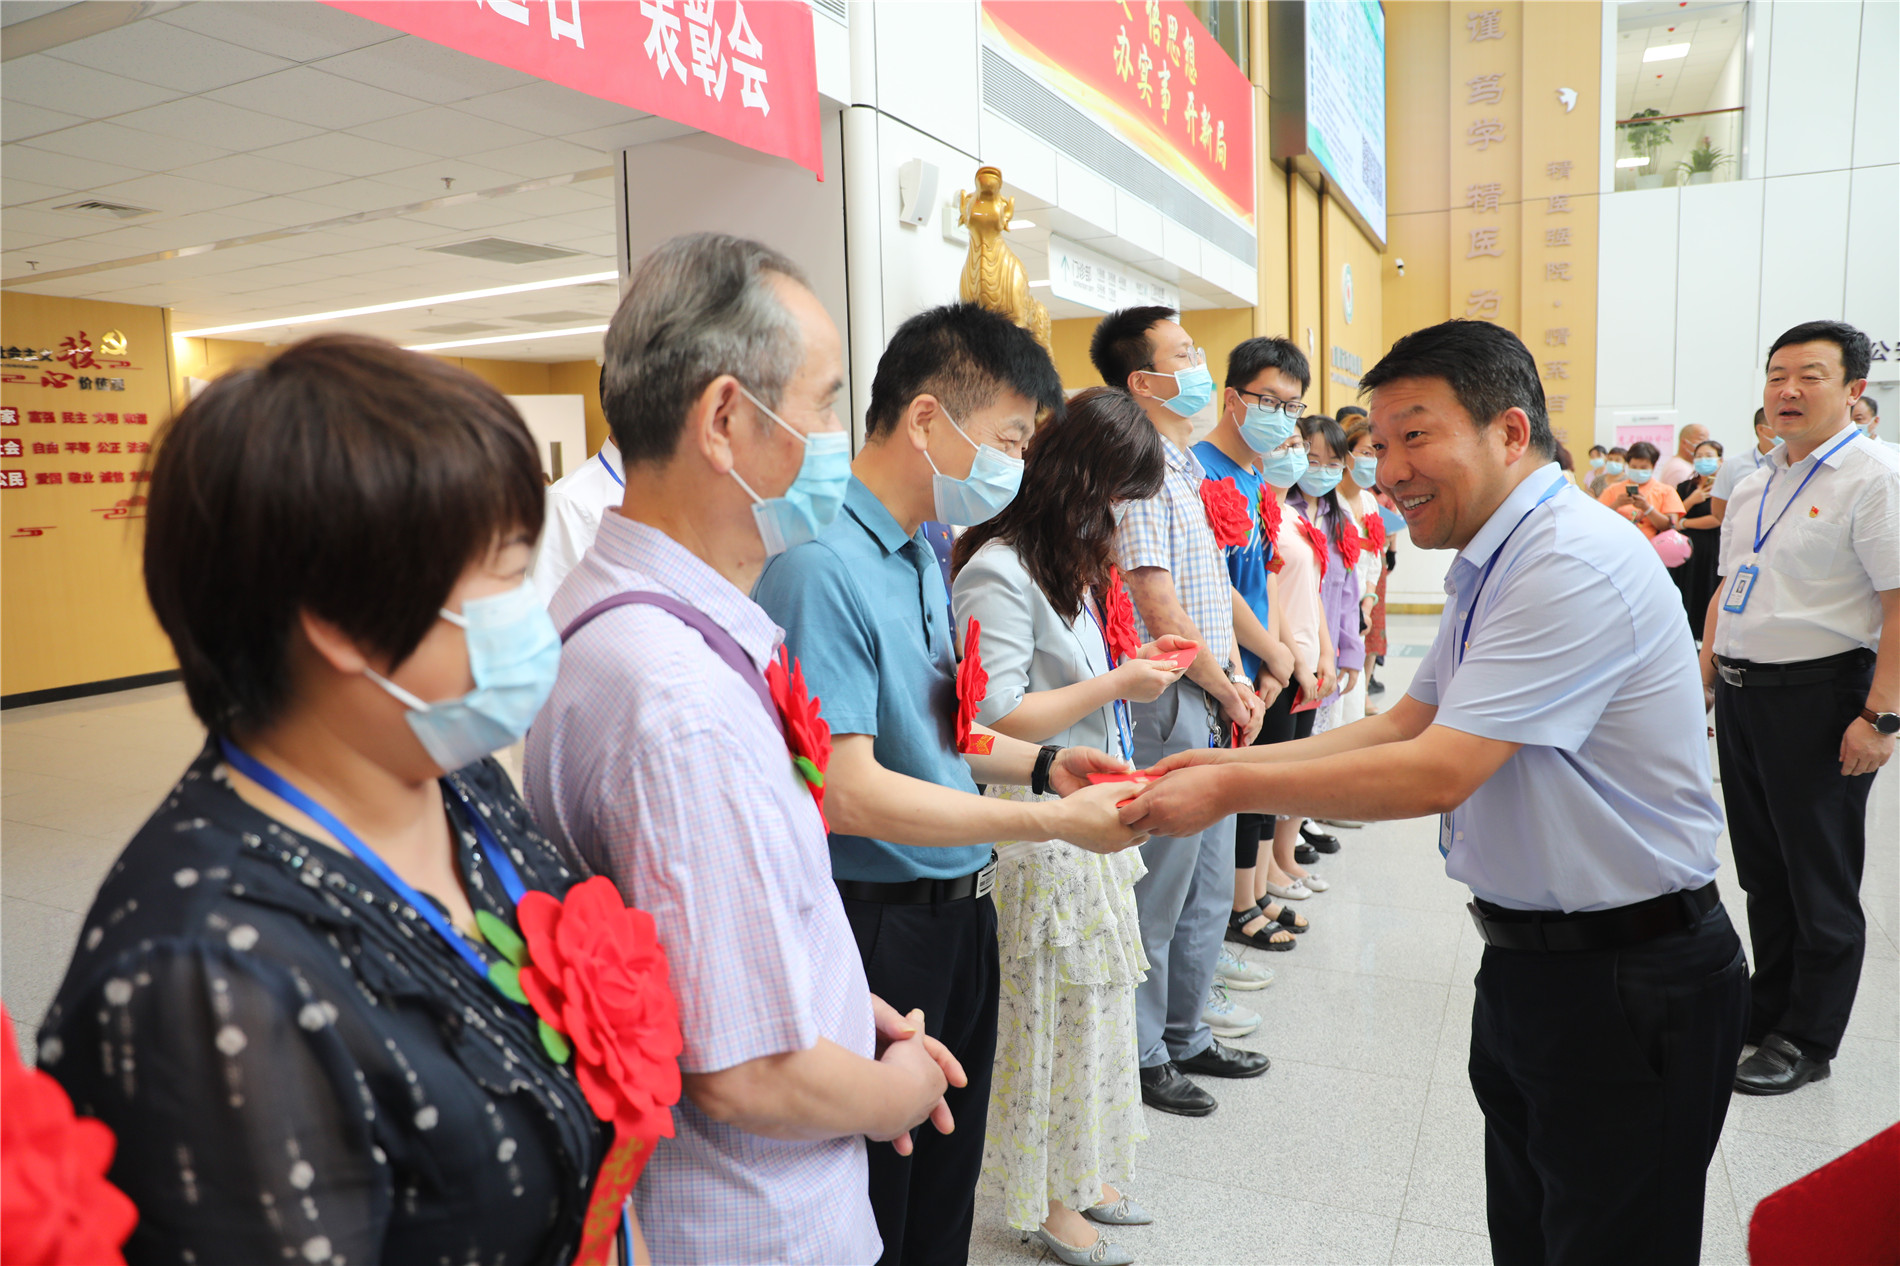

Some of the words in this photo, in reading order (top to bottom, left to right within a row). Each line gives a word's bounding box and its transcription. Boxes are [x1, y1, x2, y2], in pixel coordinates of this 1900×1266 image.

[1871, 340, 1900, 362] 公
[62, 411, 88, 424] 民主
[32, 442, 59, 454] 自由
[97, 442, 121, 454] 公正
